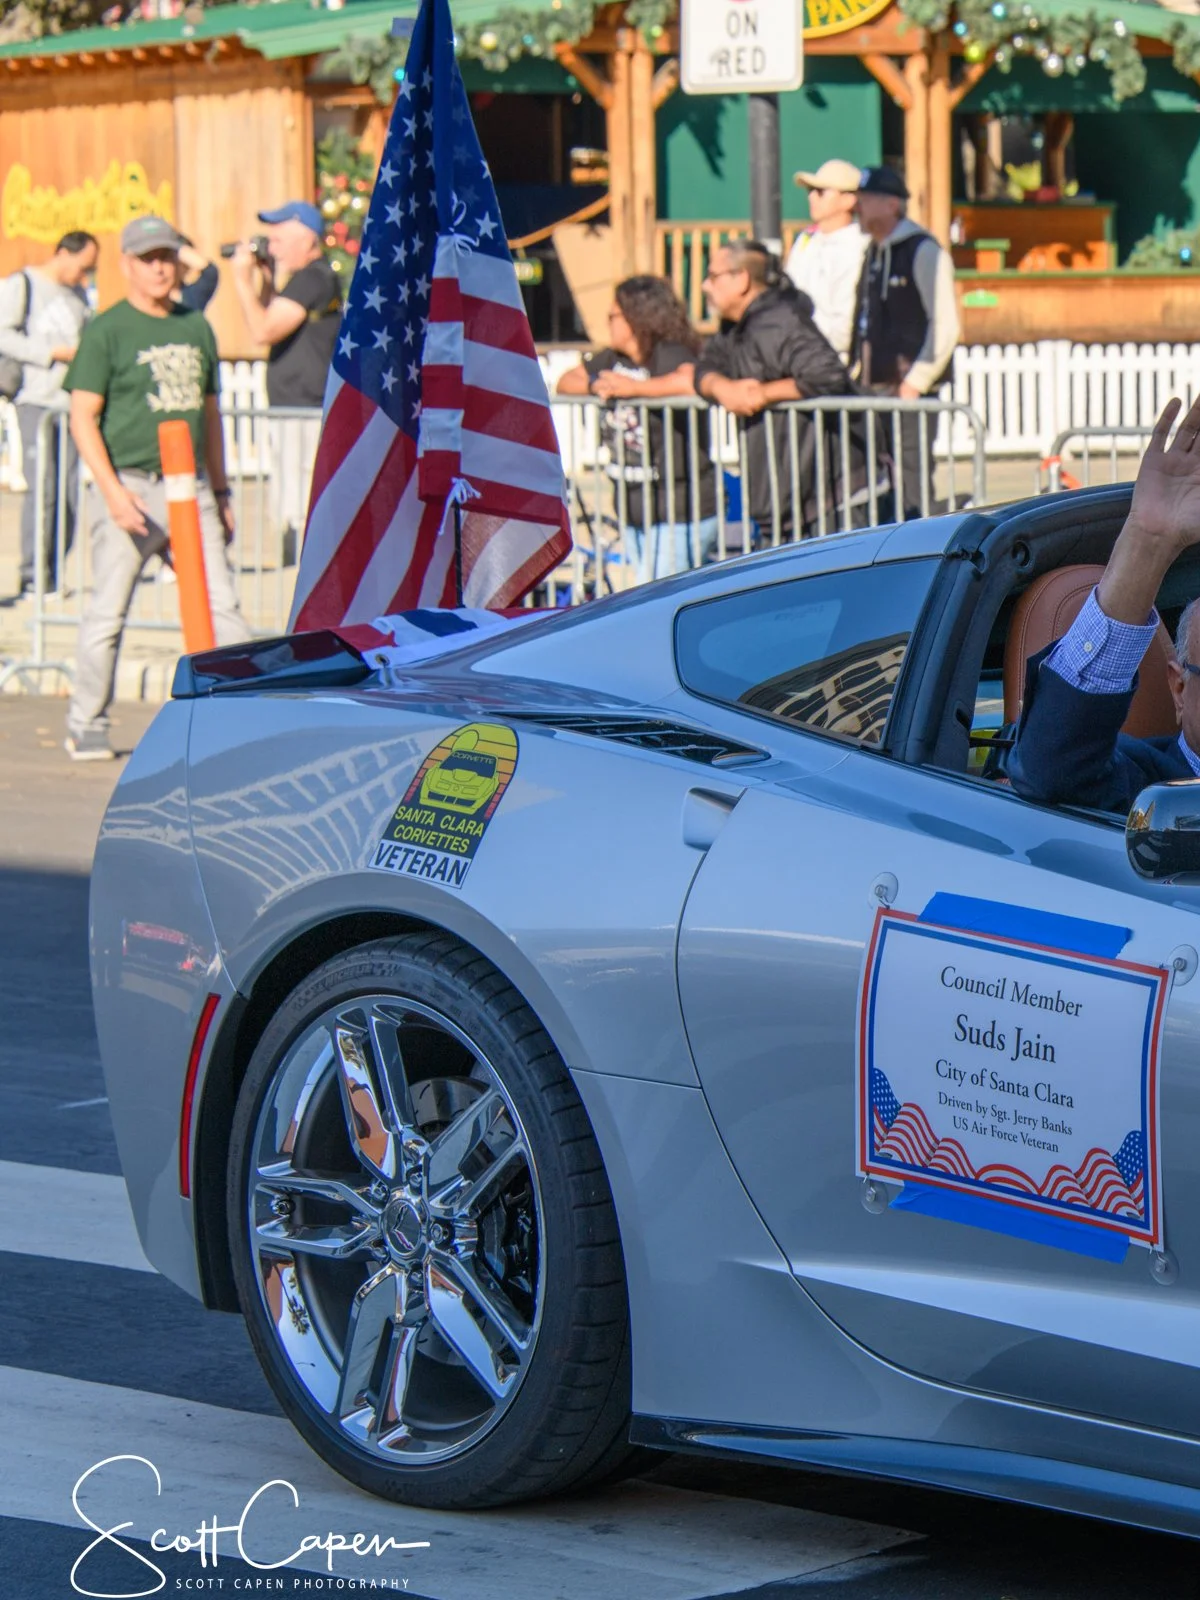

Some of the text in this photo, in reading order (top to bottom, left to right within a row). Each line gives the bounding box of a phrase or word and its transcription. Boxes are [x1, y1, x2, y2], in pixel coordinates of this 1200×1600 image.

[726, 10, 758, 38] ON
[716, 47, 767, 77] RED
[451, 750, 495, 765] CORVETTE
[393, 824, 470, 853] CORVETTES
[395, 805, 485, 837] SANTA CLARA
[374, 842, 468, 886] VETERAN
[940, 965, 1083, 1017] Council Member
[954, 1013, 1056, 1063] Suds Jain
[935, 1059, 1075, 1109] City of Santa Clara
[938, 1091, 1073, 1136] Driven by Sgt. Jerry Banks
[953, 1115, 1059, 1153] US Air Force Veteran
